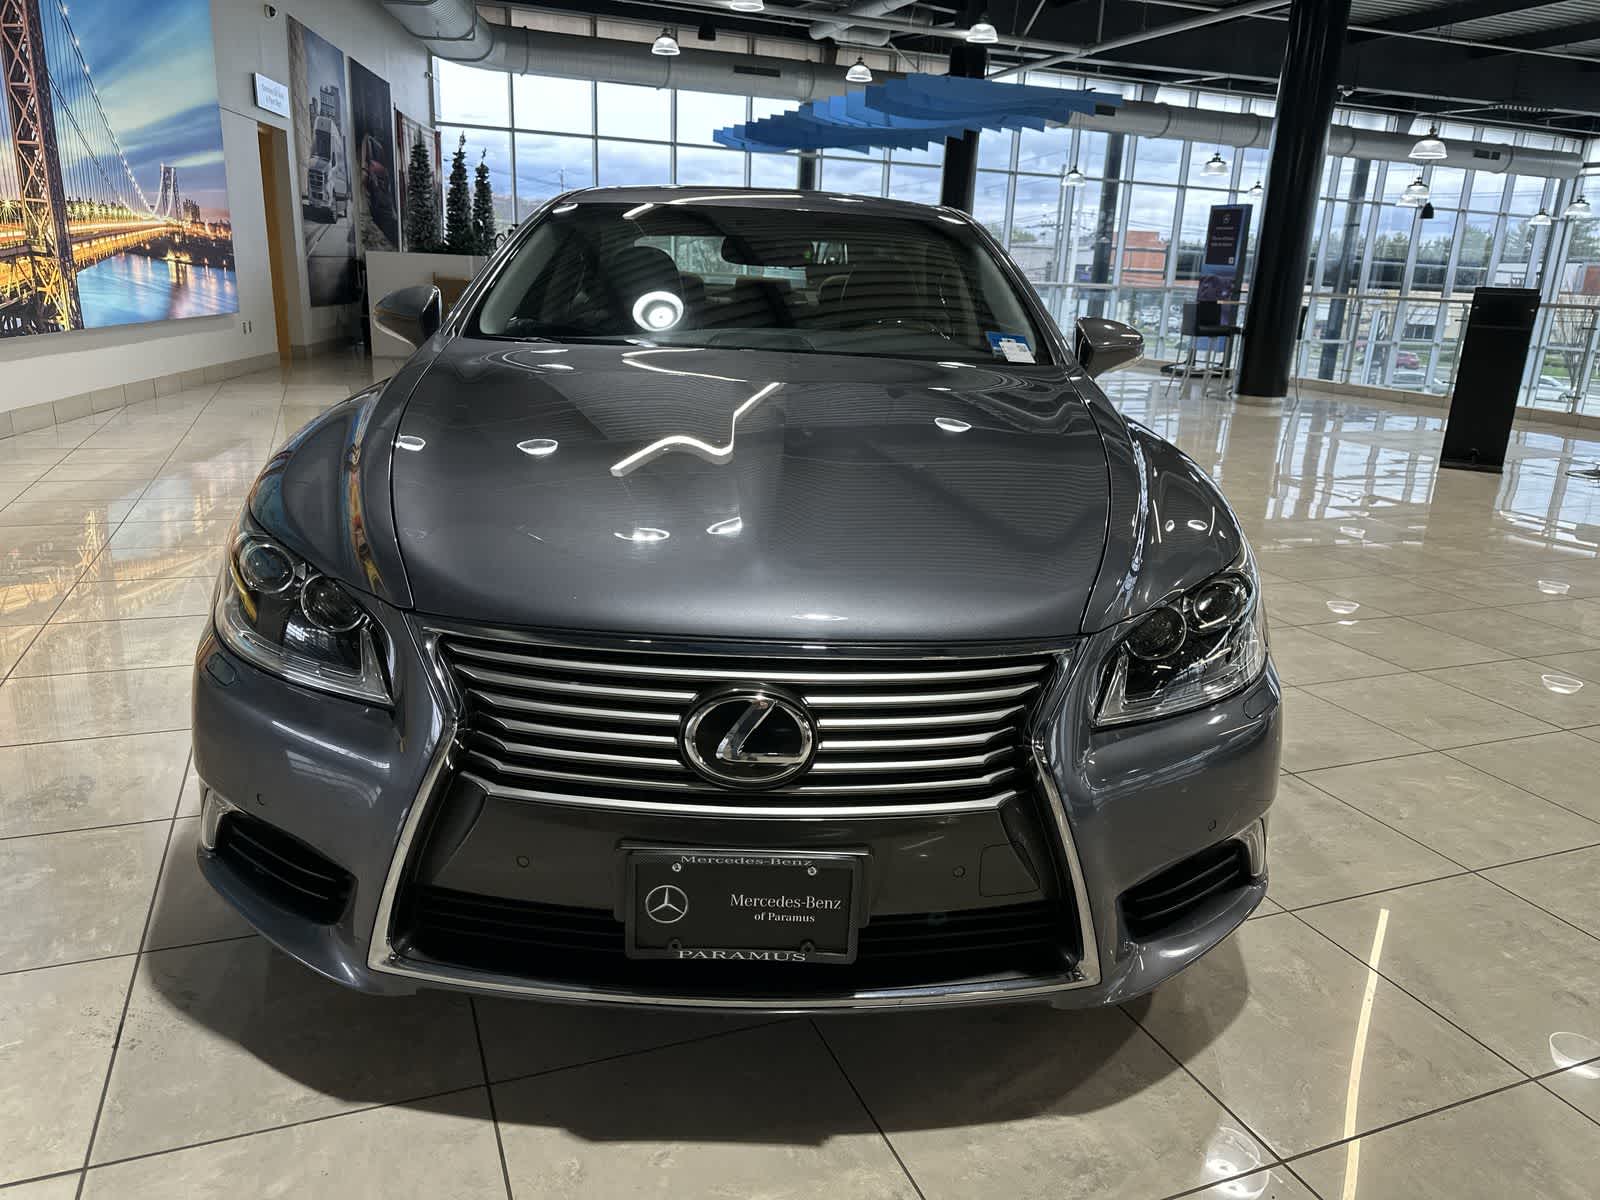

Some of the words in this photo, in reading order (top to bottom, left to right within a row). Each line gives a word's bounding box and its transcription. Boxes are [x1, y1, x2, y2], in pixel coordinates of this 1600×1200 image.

[681, 855, 812, 866] Mercedes-Benz
[730, 894, 842, 910] Mercedes-Benz
[754, 912, 765, 922] of
[768, 912, 816, 923] Paramus
[678, 950, 806, 962] PARAMUS
